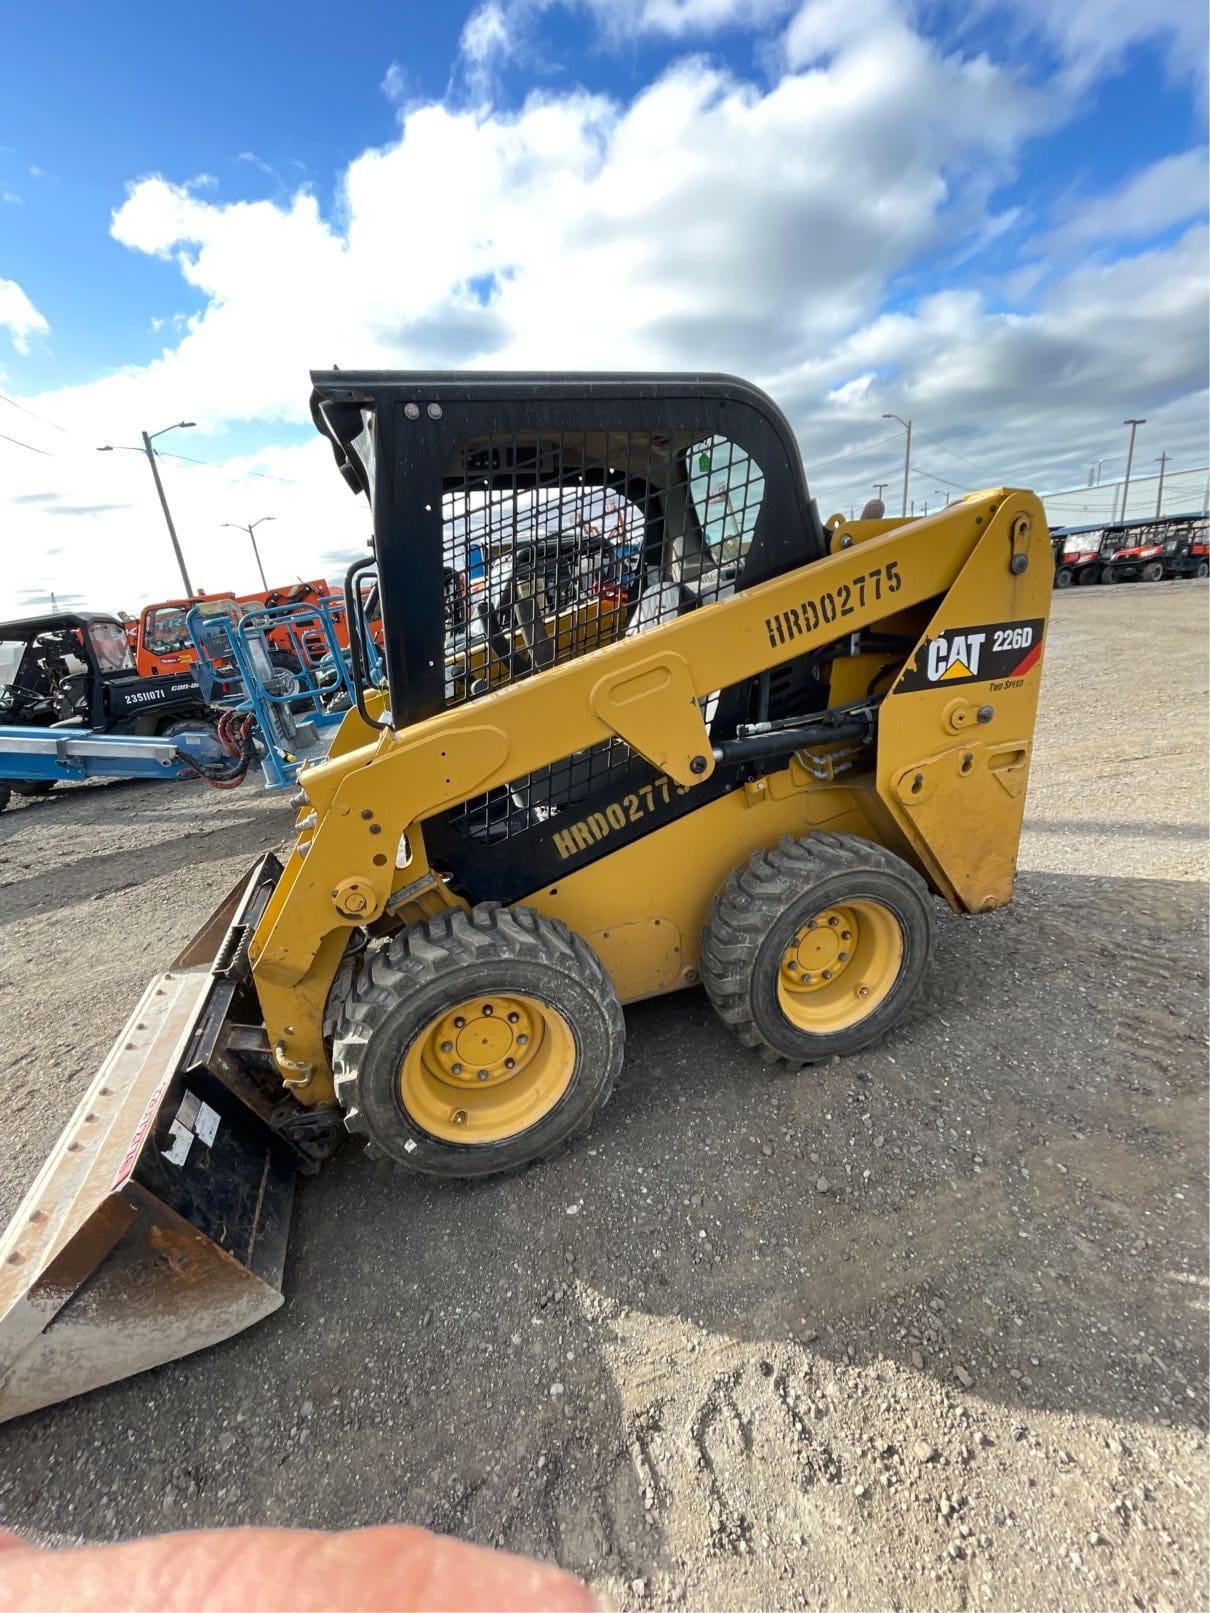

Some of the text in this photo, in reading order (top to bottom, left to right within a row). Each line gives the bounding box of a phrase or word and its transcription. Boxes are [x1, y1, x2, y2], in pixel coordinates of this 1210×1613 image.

[764, 561, 902, 649] HRD02775
[927, 627, 1033, 682] CAT 226D
[125, 690, 165, 704] 23511071
